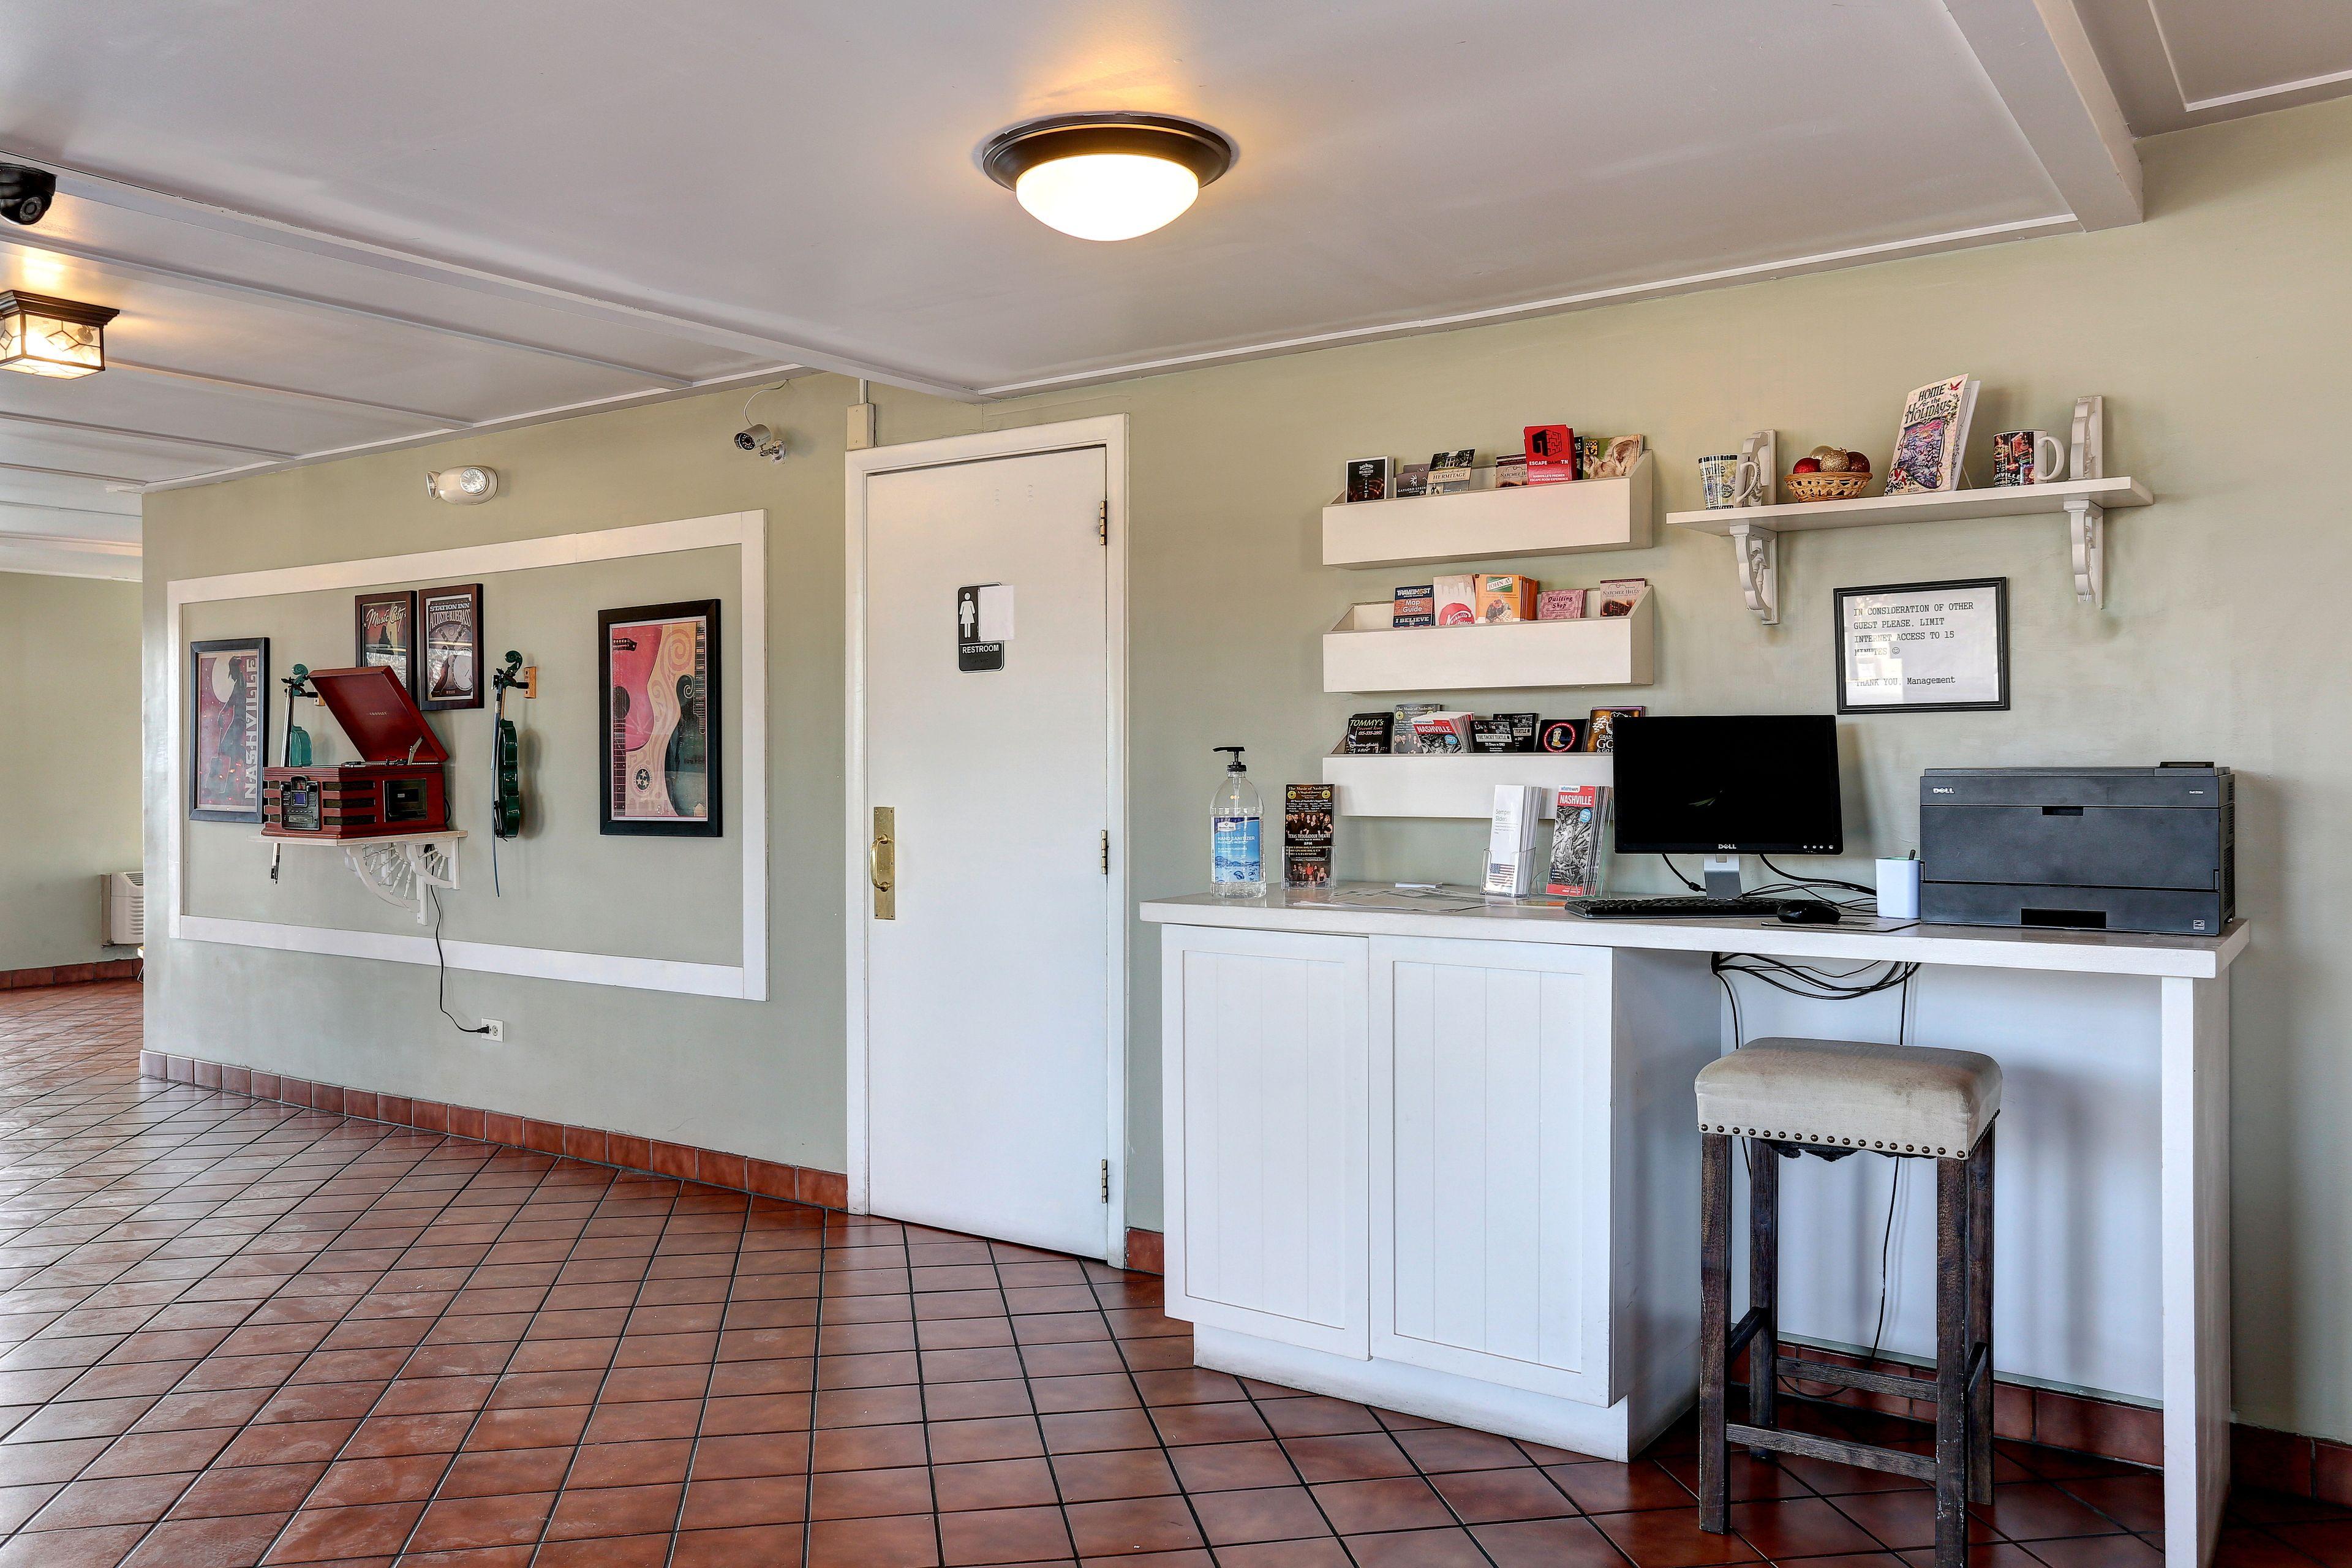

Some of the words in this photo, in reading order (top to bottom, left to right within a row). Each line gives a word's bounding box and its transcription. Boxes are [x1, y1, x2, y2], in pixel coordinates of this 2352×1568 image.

[1918, 383, 1947, 401] HOME
[1905, 400, 1952, 424] HOLIDAYS
[1488, 580, 1504, 589] JOHN
[429, 603, 458, 612] STATION
[1867, 605, 1930, 616] CONSIDERATION
[1948, 601, 1974, 611] OTHER
[366, 608, 390, 630] Music
[389, 606, 406, 633] City
[1920, 617, 1945, 626] LIMIT
[1854, 634, 1892, 643] INTERNET
[1896, 632, 1925, 641] ACCESS
[962, 644, 999, 654] RESTROOM
[1907, 676, 1956, 685] Management
[245, 657, 257, 799] NASHVILLE
[1559, 794, 1593, 805] NASHVILLE
